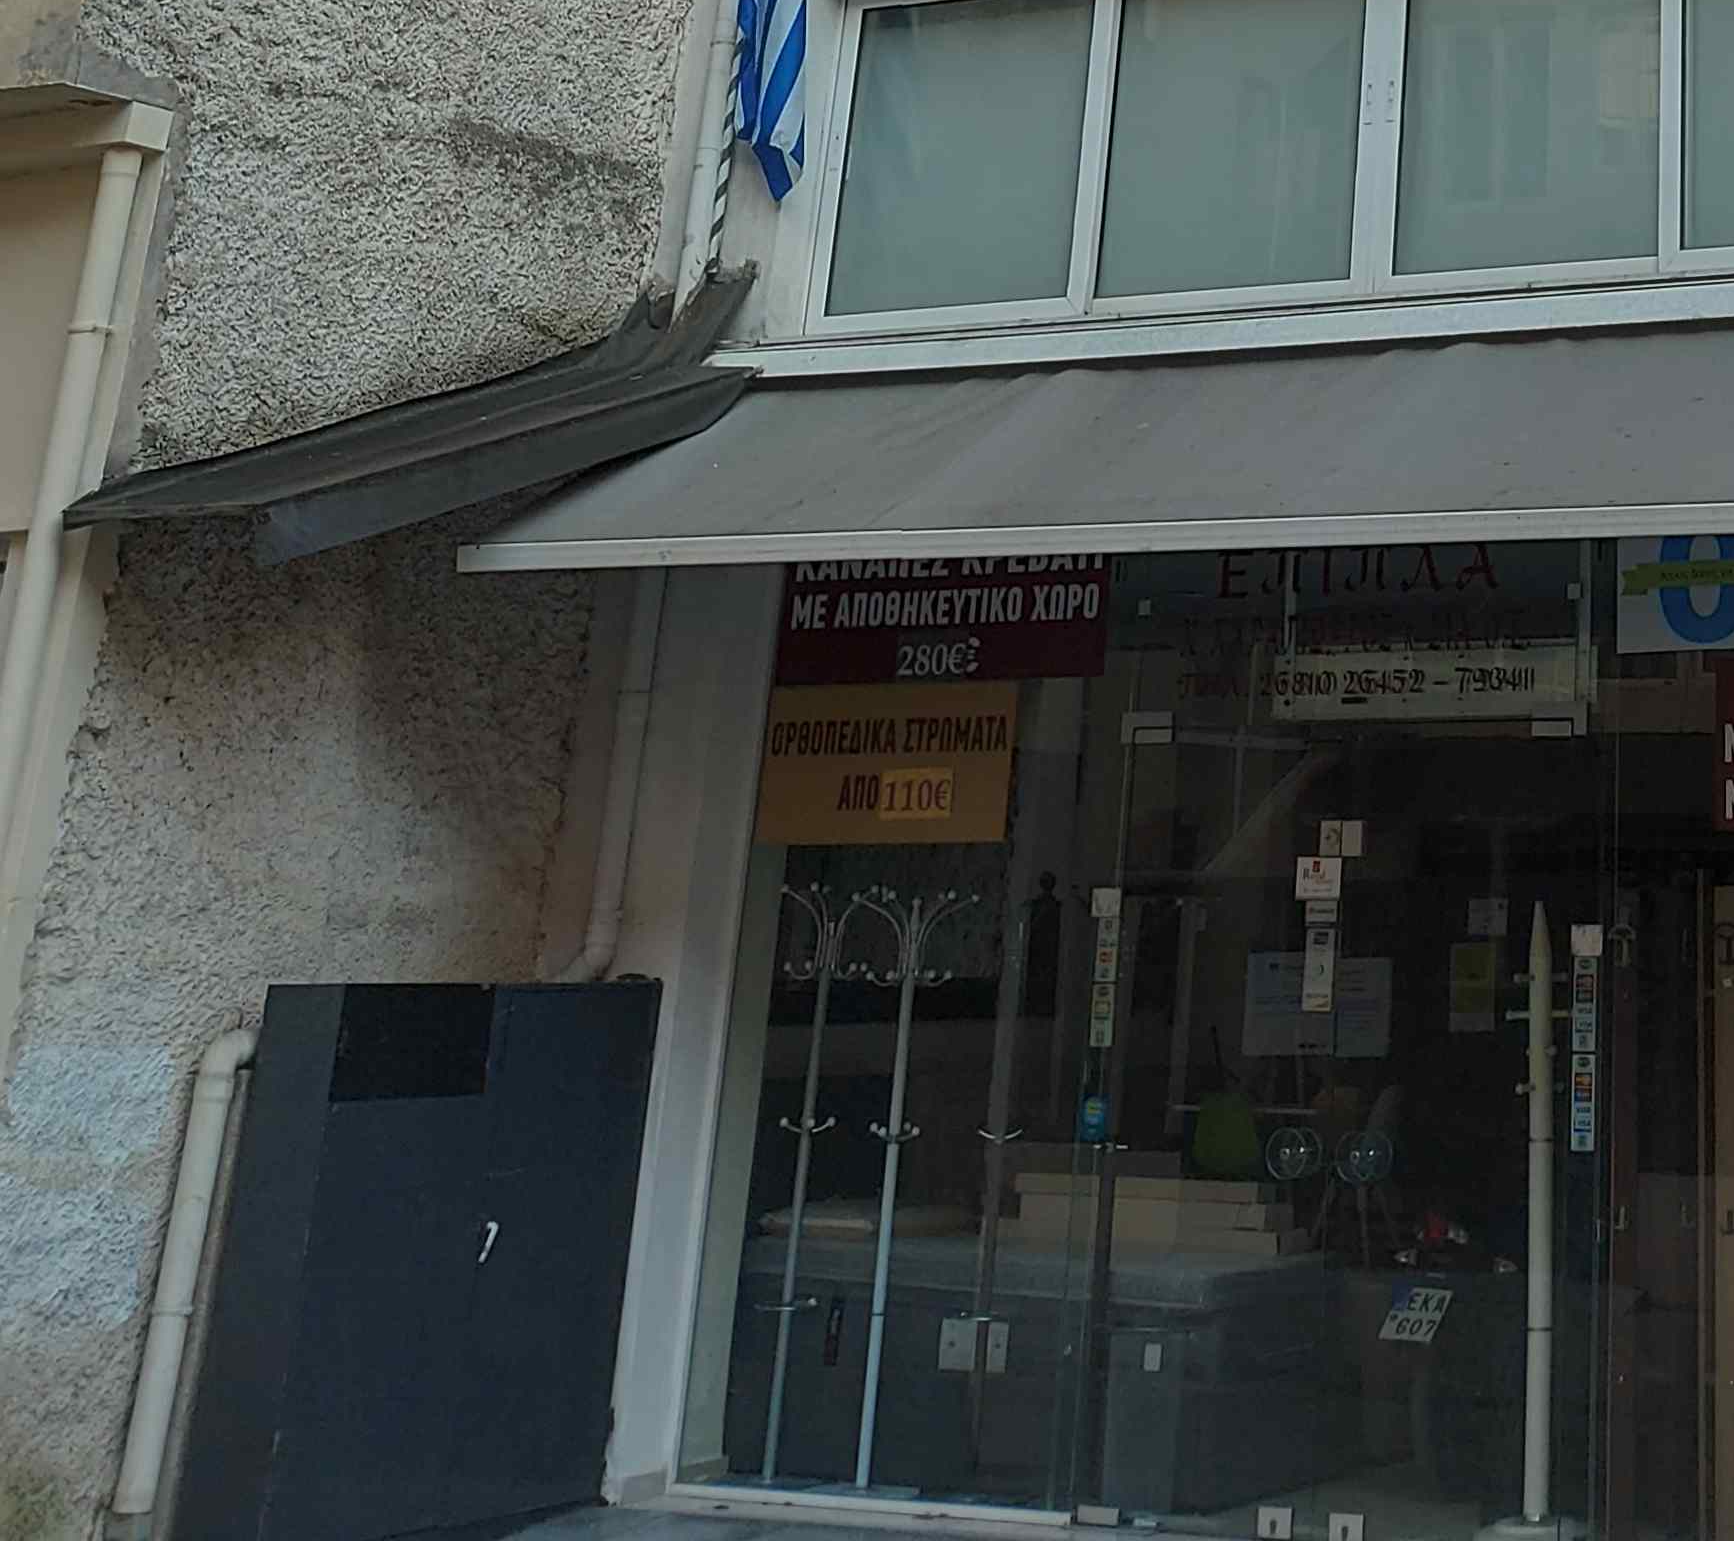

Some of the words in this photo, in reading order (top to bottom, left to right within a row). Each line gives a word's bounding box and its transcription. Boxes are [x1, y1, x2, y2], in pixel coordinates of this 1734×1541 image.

[790, 593, 829, 630] ΜΕ
[833, 587, 1023, 629] ΑΠΟΘΗΚΕΥΤΙΚΟ
[1029, 582, 1101, 622] ΧΩΡΟ
[770, 718, 897, 756] ΟΡΘΟΠΕΔΙΚΑ
[903, 714, 1008, 754] ΣΤΡΩΜΑΤΑ
[837, 773, 880, 812] ΑΠΟ
[882, 776, 951, 814] 110€
